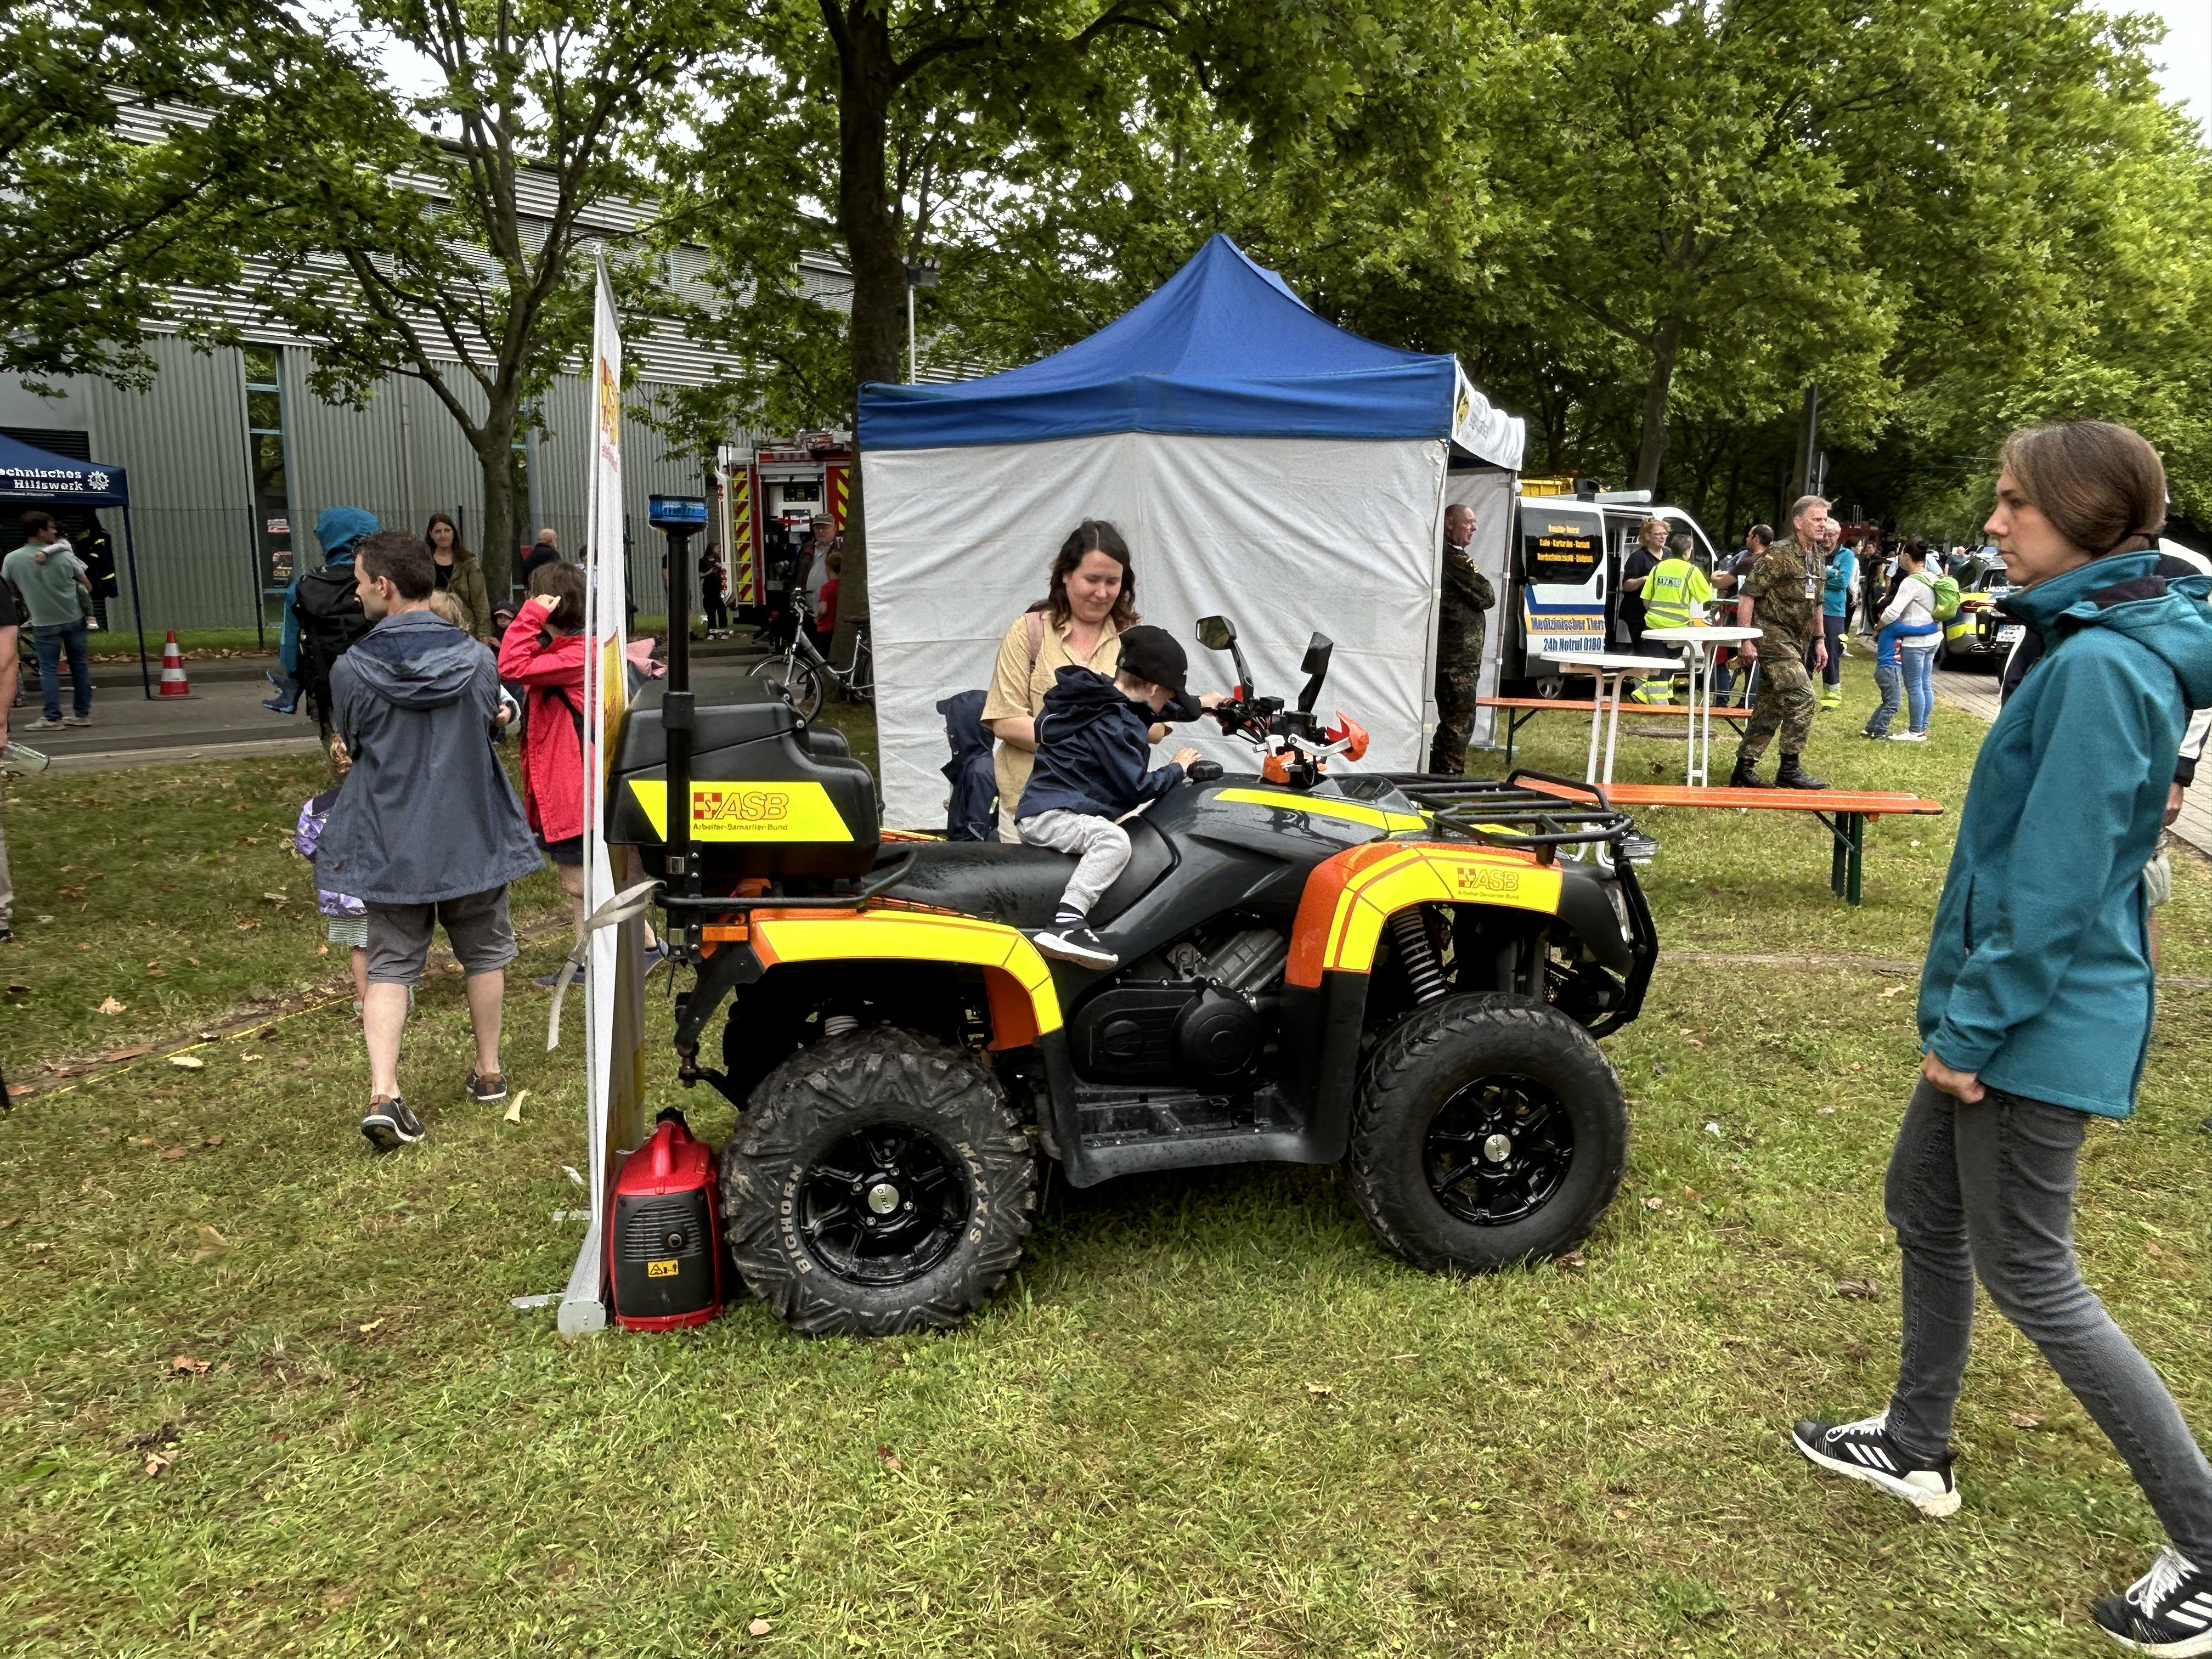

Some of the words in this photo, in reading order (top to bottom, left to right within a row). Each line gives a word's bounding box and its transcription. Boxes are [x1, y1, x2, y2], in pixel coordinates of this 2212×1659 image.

[0, 467, 82, 478] echnisches
[14, 479, 83, 491] Hilfswerk
[1559, 637, 1582, 651] Notruf
[715, 791, 789, 821] ASB
[1472, 869, 1519, 891] ASB
[956, 1142, 989, 1244] MAXXIS
[781, 1164, 812, 1274] BIGHORN
